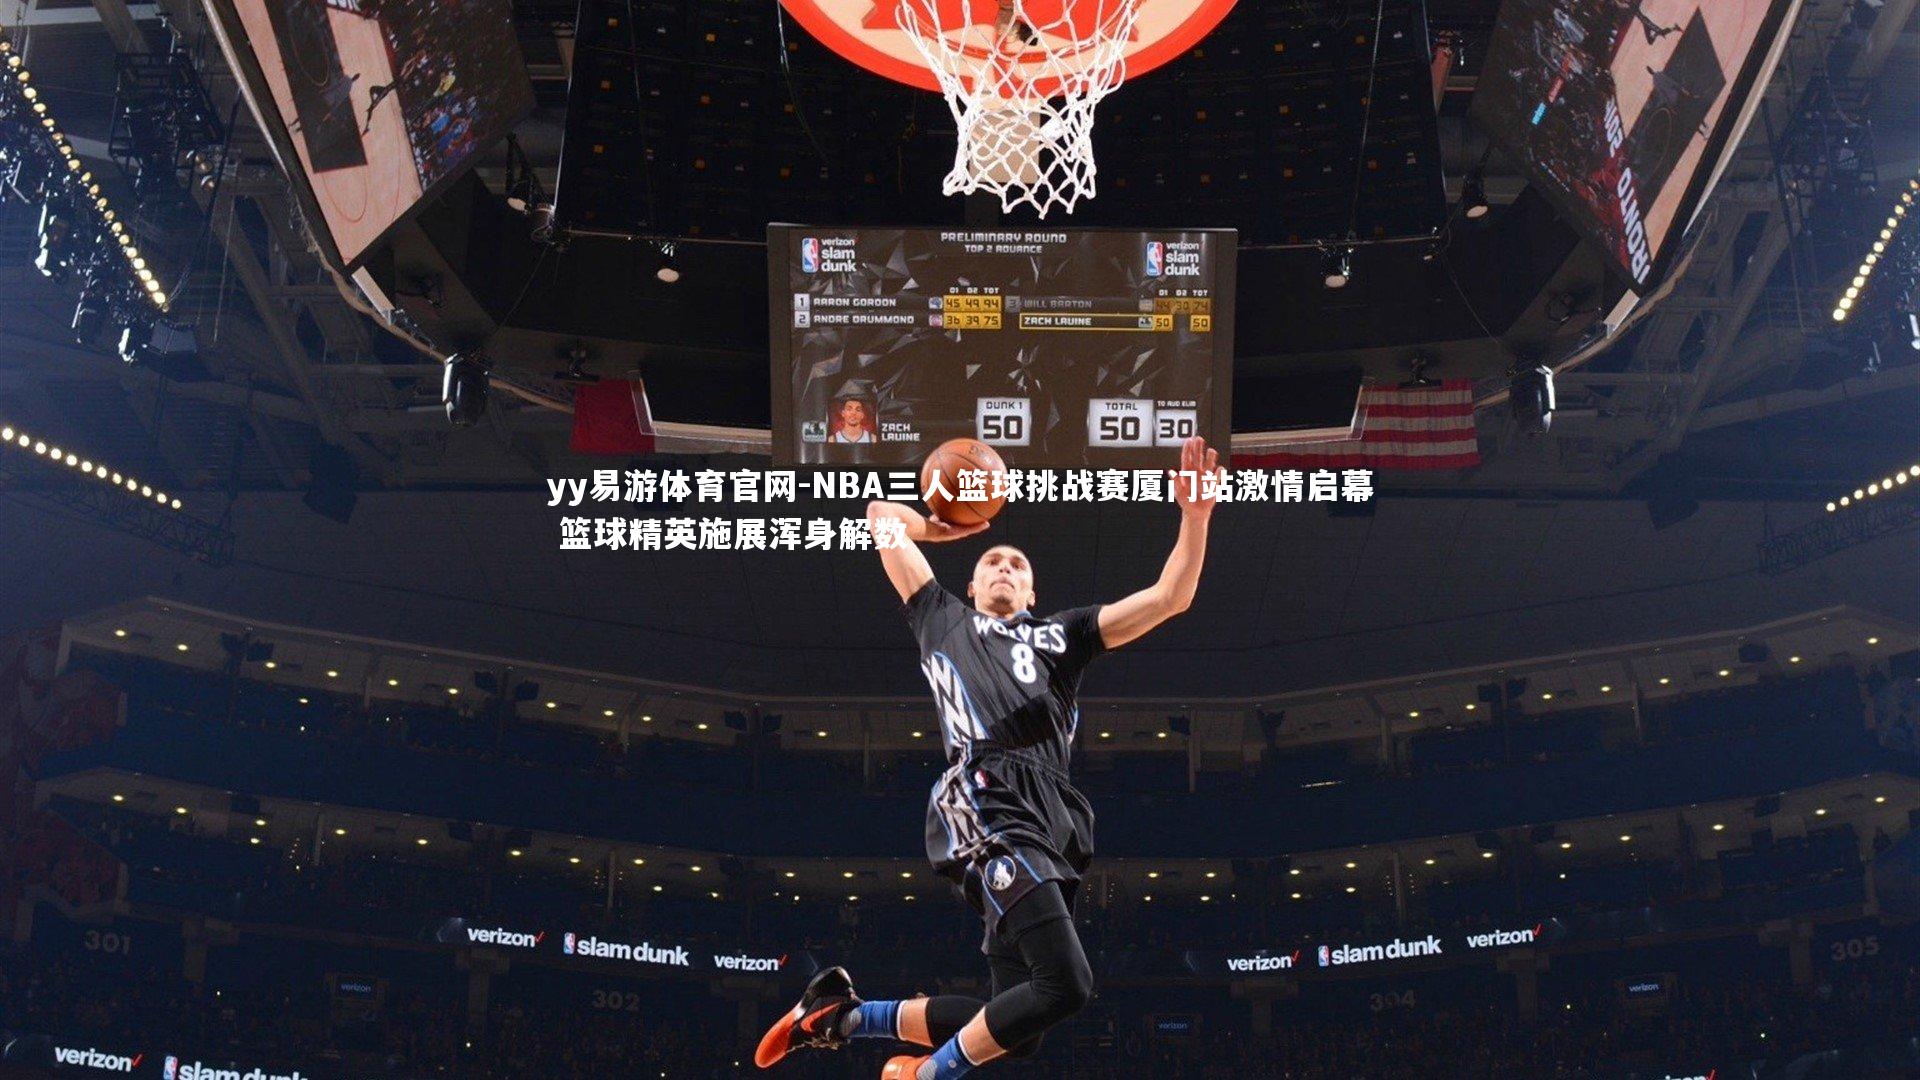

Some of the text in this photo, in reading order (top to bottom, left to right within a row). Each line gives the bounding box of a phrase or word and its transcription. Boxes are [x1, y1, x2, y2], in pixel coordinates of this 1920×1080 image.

[821, 237, 855, 246] verizon
[940, 232, 1067, 243] PRELIMINARY ROUND
[964, 244, 1043, 254] TOP 2 ADVANCE
[1165, 241, 1200, 250] verizon
[821, 246, 856, 260] slam
[1165, 250, 1200, 263] slam
[821, 260, 857, 272] dunk
[1164, 263, 1201, 276] dunk
[813, 298, 850, 306] AARON
[853, 299, 897, 307] GORDON
[946, 299, 960, 308] 45
[966, 299, 980, 308] 49
[984, 299, 999, 308] 94
[813, 315, 850, 323] ANDRE
[852, 316, 915, 324] DRUMMOND
[966, 315, 980, 325] 39
[984, 315, 999, 325] 75
[1024, 317, 1208, 328] ZACH LAVINE 50 50
[986, 401, 1015, 410] DUNK
[1106, 402, 1138, 411] TOTAL
[881, 422, 911, 432] ZACH
[983, 415, 1023, 440] 50
[1100, 416, 1141, 441] 50
[1159, 418, 1193, 438] 30
[881, 432, 920, 442] LAVINE
[973, 615, 1067, 654] WOLVES
[1011, 643, 1037, 683] 8
[467, 926, 536, 948] verizon
[1466, 928, 1534, 949] verizon
[577, 936, 690, 967] slam dunk
[1331, 935, 1443, 966] slam dunk
[713, 954, 780, 972] verizon
[1226, 954, 1292, 972] verizon
[340, 982, 372, 993] verizon
[1628, 982, 1660, 992] verizon
[55, 1046, 132, 1073] verizon
